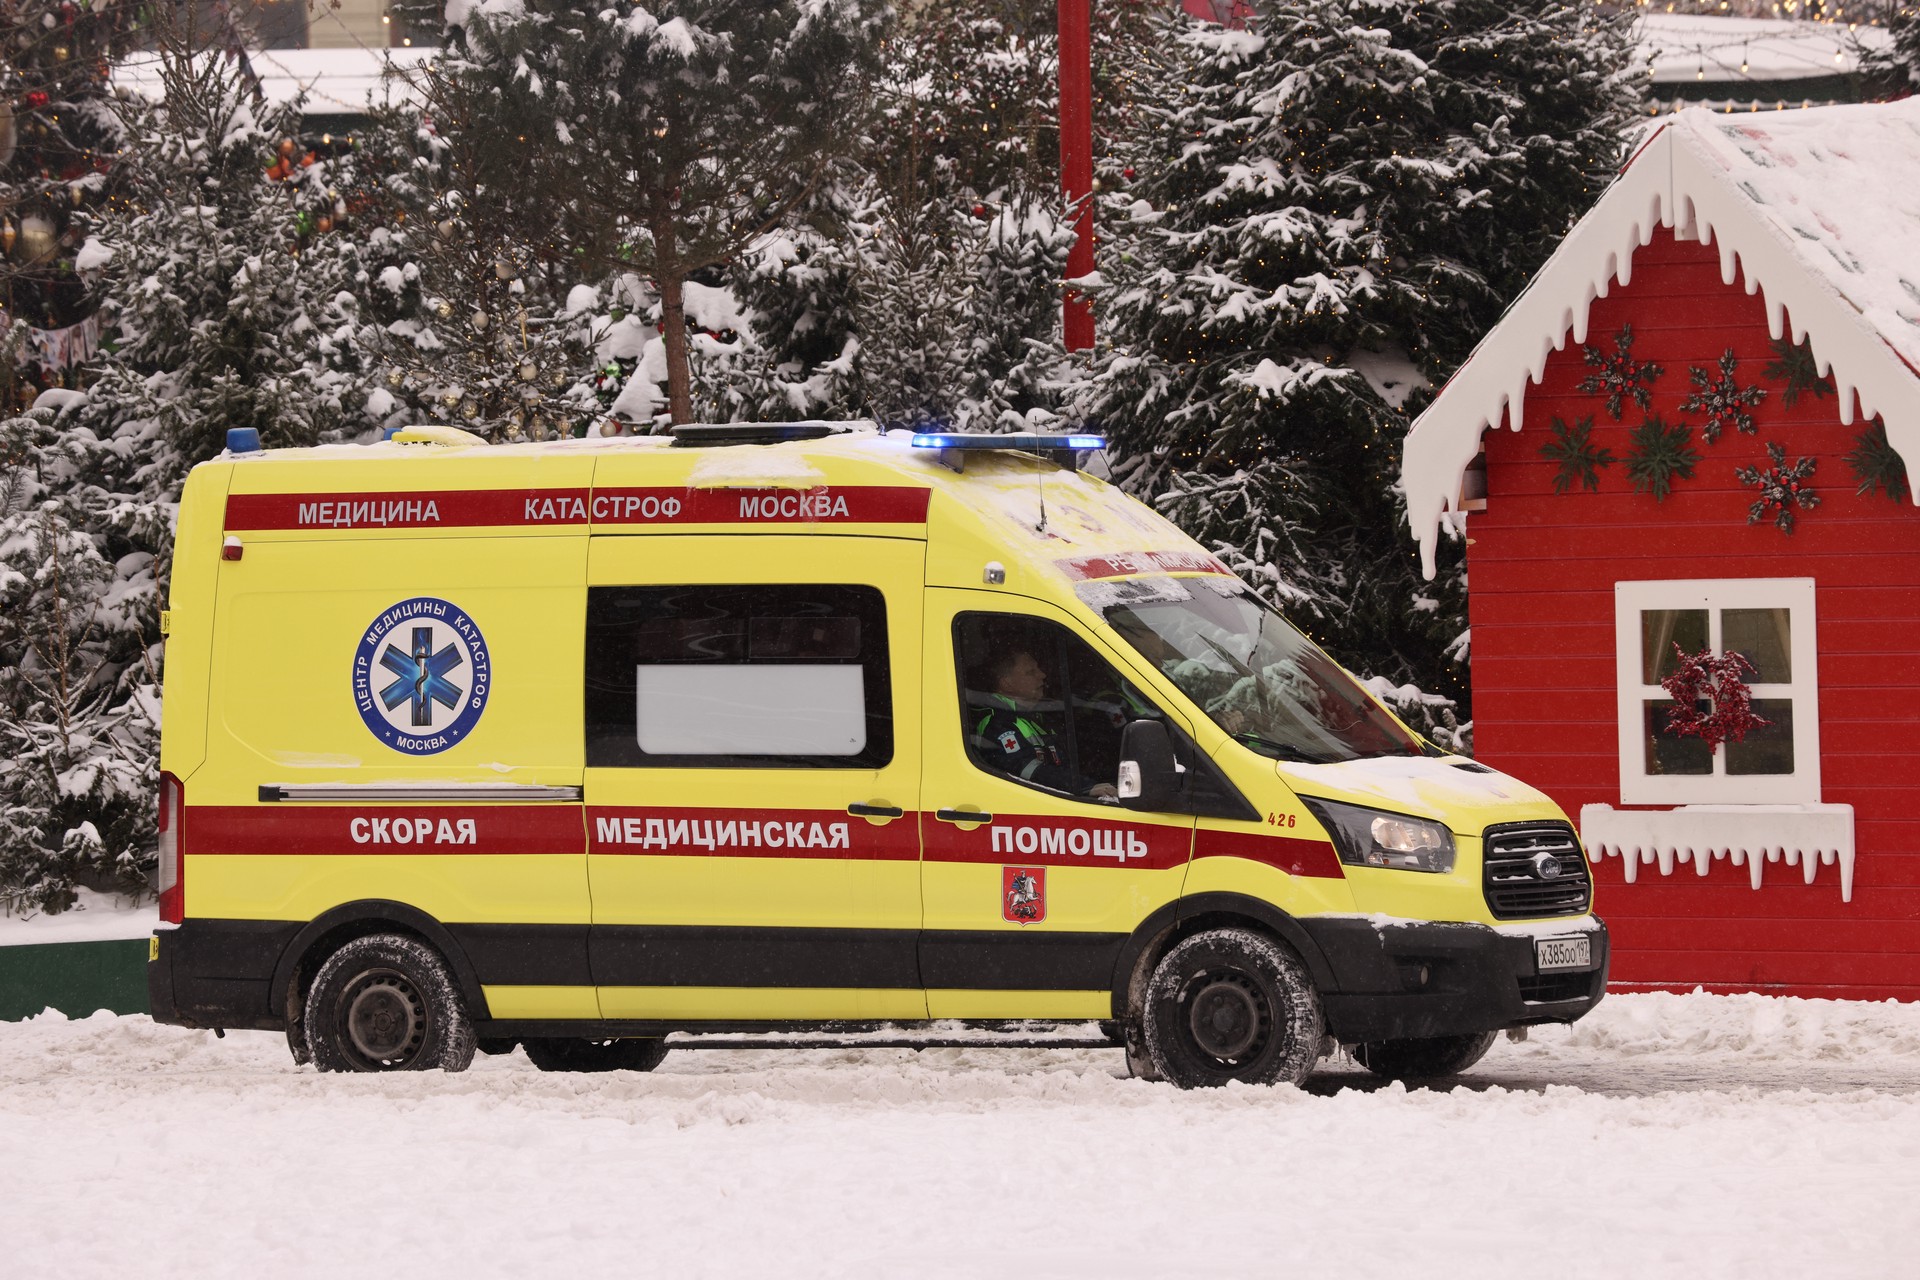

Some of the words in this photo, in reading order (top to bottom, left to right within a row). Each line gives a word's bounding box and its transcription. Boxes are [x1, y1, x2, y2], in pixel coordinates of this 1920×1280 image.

[298, 500, 441, 528] МЕДИЦИНА
[524, 496, 682, 520] КАТАСТРОФ
[739, 495, 850, 518] МОСКВА
[356, 656, 373, 712] ЦЕНТР
[366, 602, 447, 646] МЕДИЦИНЫ
[454, 615, 487, 709] КАТАСТРОФ
[396, 735, 448, 751] МОСКВА
[1267, 812, 1296, 828] 426
[350, 817, 477, 845] СКОРАЯ
[596, 817, 850, 851] МЕДИЦИНСКАЯ
[991, 826, 1148, 863] ПОМОЩЬ
